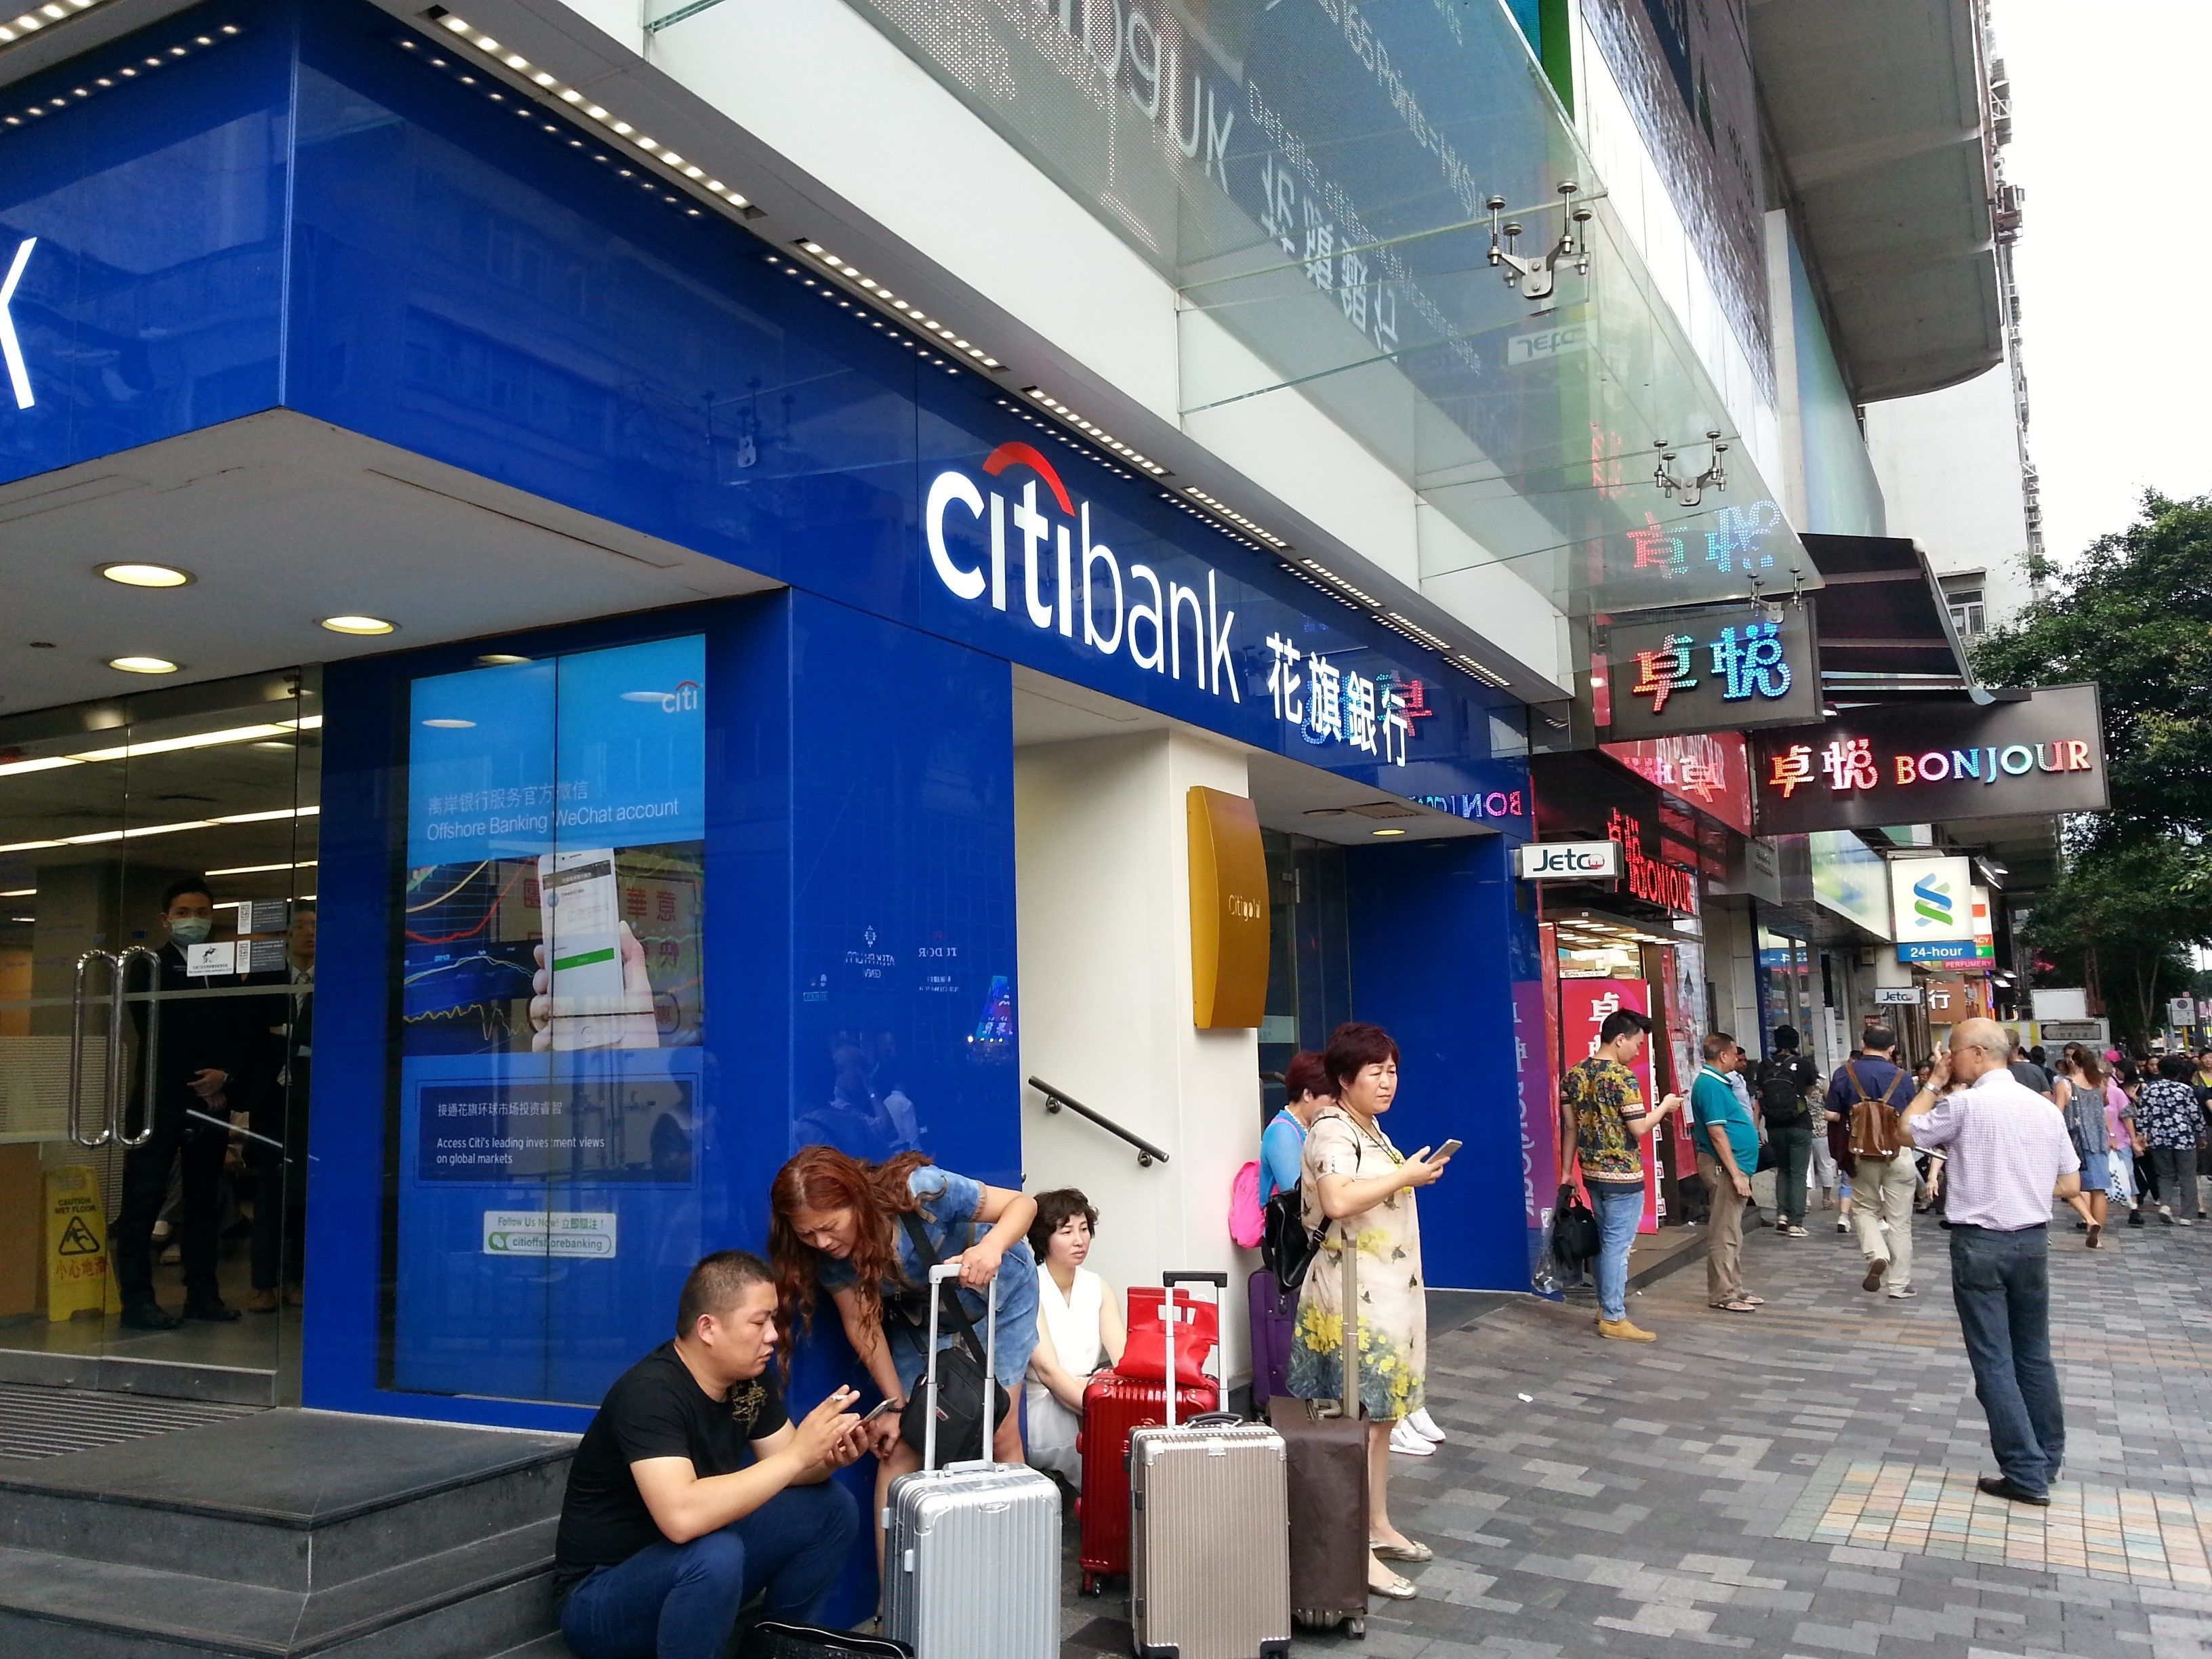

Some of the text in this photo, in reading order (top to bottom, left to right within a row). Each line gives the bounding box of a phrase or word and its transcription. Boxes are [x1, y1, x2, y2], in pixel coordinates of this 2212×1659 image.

[926, 442, 1240, 703] citibank
[661, 680, 698, 713] citi
[1266, 632, 1408, 767] 花旗銀行
[1896, 739, 2092, 786] BONJOUR
[428, 798, 679, 841] Offshore Banking WeChat account
[1533, 848, 1605, 872] Jetco
[1910, 947, 1963, 958] 24-hour
[436, 1138, 466, 1148] Access
[469, 1137, 489, 1148] Citi's
[492, 1137, 524, 1151] leading
[579, 1136, 605, 1147] views
[436, 1153, 513, 1166] on global markets
[498, 1217, 523, 1227] Follow
[525, 1218, 535, 1227] Us
